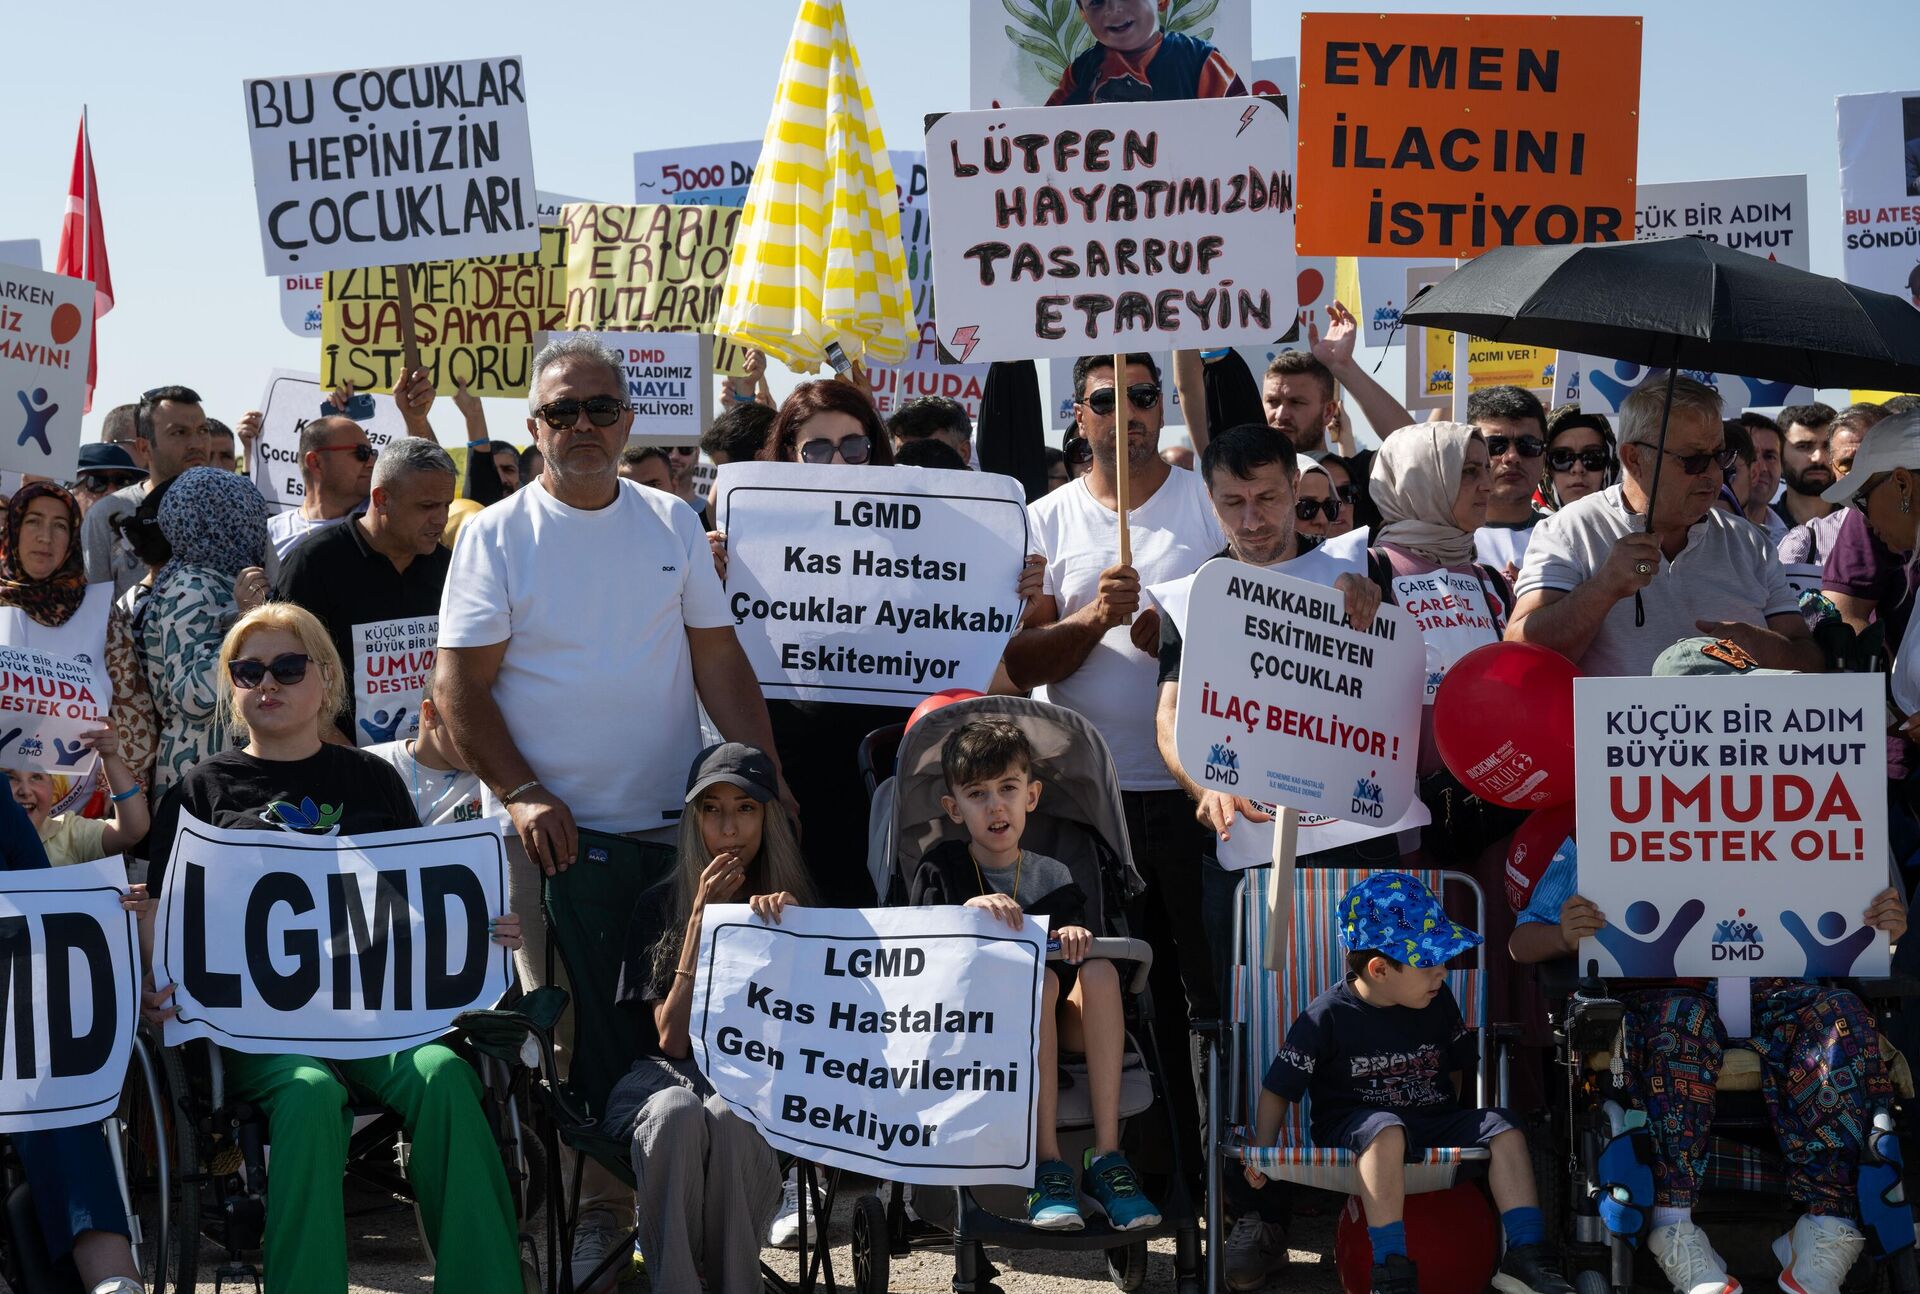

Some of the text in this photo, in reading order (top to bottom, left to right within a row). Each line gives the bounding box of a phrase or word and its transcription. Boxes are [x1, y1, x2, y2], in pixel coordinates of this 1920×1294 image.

[1325, 41, 1560, 93] EYMEN
[251, 59, 525, 129] BU ÇOCUKLAR
[289, 114, 500, 181] HEPİNİZİN
[951, 124, 1159, 177] LÜTFEN
[1332, 112, 1585, 176] İLACINI
[661, 164, 725, 195] 5000
[268, 176, 534, 261] ÇOCUKLARI.
[1367, 188, 1624, 247] İSTİYOR
[1685, 202, 1722, 227] BİR
[1729, 202, 1791, 224] ADIM
[1846, 208, 1871, 225] BU
[1727, 230, 1793, 249] UMUT
[1847, 227, 1920, 250] SÖNDÜ
[589, 241, 732, 284] ERİYO
[963, 235, 1225, 287] TASARRUF
[0, 280, 54, 306] RKEN
[1035, 279, 1272, 340] ETMEYİN
[304, 322, 322, 331] DM
[342, 300, 566, 347] YAŞAMAK
[325, 344, 534, 390] İSTYORU
[621, 366, 692, 378] VLADIMIZ
[629, 349, 665, 363] DMD
[1507, 349, 1529, 361] VER
[834, 500, 921, 530] LGMD
[783, 546, 966, 582] Kas Hastası
[1399, 575, 1480, 596] ÇARE VRKEN
[730, 591, 1012, 634] Çocuklar Ayakkabı
[1227, 576, 1396, 641] AYAKKABILAINI
[364, 623, 406, 641] KÜÇÜK
[408, 621, 426, 635] BİR
[366, 639, 406, 653] BÜYÜK
[408, 636, 426, 649] BİR
[1244, 615, 1373, 668] ESKİTMEYEN
[32, 654, 52, 668] BİR
[56, 661, 88, 675] ADIM
[34, 665, 54, 678] BİR
[57, 671, 91, 685] UMUT
[781, 643, 960, 684] Eskitemiyor
[1250, 652, 1363, 699] ÇOCUKLAR
[367, 674, 426, 694] DESTEK
[67, 704, 98, 721] OL!
[1201, 681, 1260, 733] İLAÇ
[1266, 705, 1386, 760] BEKLİYOR
[1607, 703, 1863, 741] KÜÇÜK BİR ADIM
[18, 747, 42, 757] DMD
[1607, 739, 1866, 767] BÜYÜK BİR UMUT
[1204, 764, 1239, 786] DMD
[1351, 798, 1384, 819] DMD
[1609, 771, 1863, 823] UMUDA
[1610, 828, 1864, 862] DESTEK OL!
[183, 861, 489, 1011] LGMD
[1711, 943, 1764, 961] DMD
[824, 947, 925, 978] LGMD
[747, 981, 994, 1034] Kas Hastaları
[716, 1026, 1017, 1092] Gen Tedavilerini
[782, 1094, 938, 1150] Bekliyor
